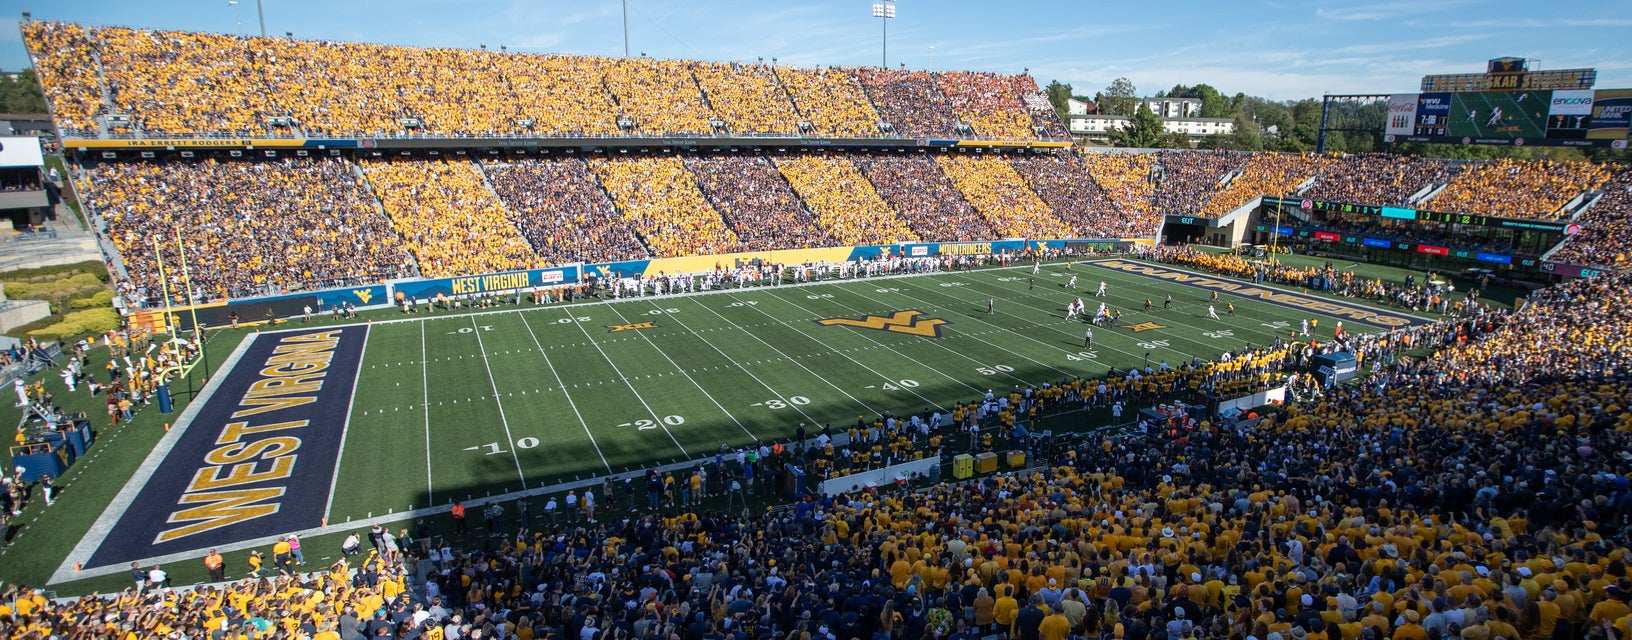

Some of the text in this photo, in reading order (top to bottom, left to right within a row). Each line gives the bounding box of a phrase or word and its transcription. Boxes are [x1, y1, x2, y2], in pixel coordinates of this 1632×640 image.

[1472, 75, 1519, 90] PUSKAR
[1522, 73, 1578, 88] STADIUM
[1601, 105, 1632, 113] UNITED
[938, 242, 992, 256] MOUNTAINEERS
[1543, 263, 1554, 271] 40
[451, 271, 529, 295] WEST VIRGINIA
[1101, 260, 1411, 327] MOUNTAINEERS
[975, 364, 1015, 376] 50
[882, 379, 920, 391] 40
[765, 395, 812, 410] 30
[634, 414, 686, 432] 20
[152, 328, 343, 546] WEST VIRGINIA
[483, 436, 541, 456] 10
[1100, 578, 1109, 587] 10
